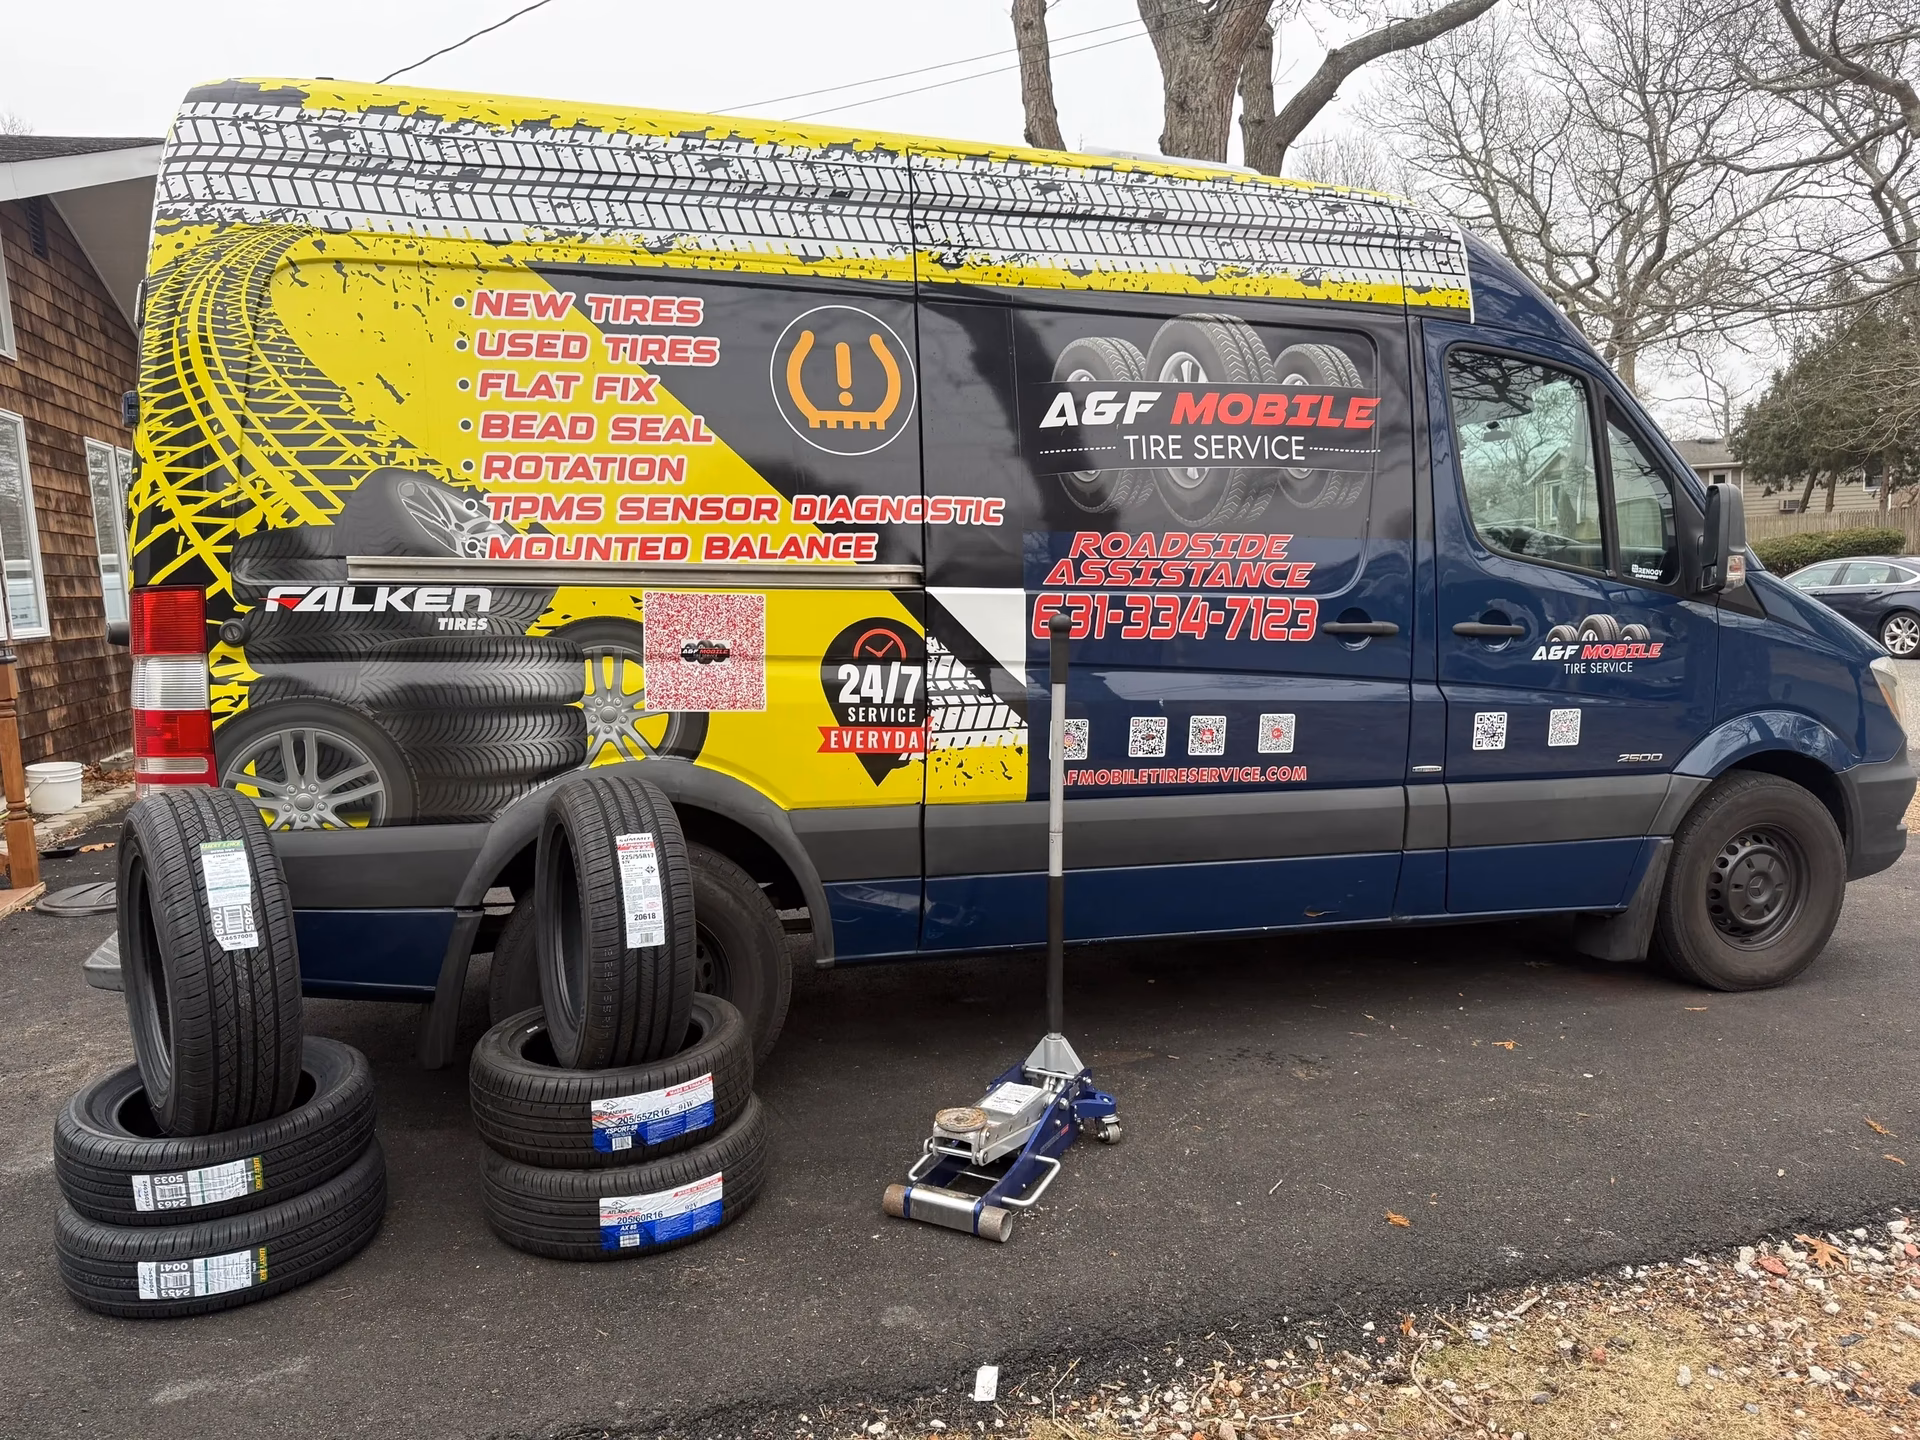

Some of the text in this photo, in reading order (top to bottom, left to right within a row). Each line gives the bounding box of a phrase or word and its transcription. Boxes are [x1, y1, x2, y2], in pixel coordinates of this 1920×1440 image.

[470, 289, 704, 327] NEW TIRES
[473, 331, 720, 367] USED TIRES
[476, 372, 661, 404] FLAT FIX
[1039, 391, 1382, 430] A&F MOBILE
[478, 412, 716, 445] BEAD SEAL
[1123, 434, 1306, 461] TIRE SERVICE
[480, 454, 688, 484] ROTATION
[483, 493, 1006, 527] TPMS SENSOR DIAGNOSTIC
[486, 533, 880, 564] MOUNTED BALANCE
[1068, 531, 1294, 560] ROADSIDE
[1042, 558, 1316, 589] ASSISTANCE
[1638, 567, 1663, 576] RENOGY
[263, 587, 492, 613] FALKEN
[438, 617, 488, 632] TIRES
[1032, 593, 1319, 642] 631-334-7123
[1532, 642, 1664, 661] A&F MOBILE
[1564, 661, 1633, 675] TIRE SERVICE
[837, 661, 922, 705] 24/7
[847, 707, 916, 723] SERVICE
[830, 730, 932, 750] EVERYDAY
[1617, 753, 1663, 763] 2500
[1063, 766, 1307, 786] FMOBILETIRESERVICE.COM
[212, 907, 224, 935] 7008
[243, 904, 255, 932] 2465
[634, 913, 656, 921] 20618
[617, 1100, 694, 1126] 205/55ZR16 91W
[154, 1174, 184, 1184] 5033
[157, 1199, 187, 1209] 2463
[617, 1211, 663, 1225] 205/60R16
[160, 1262, 189, 1272] 0041
[161, 1288, 190, 1298] 2453
